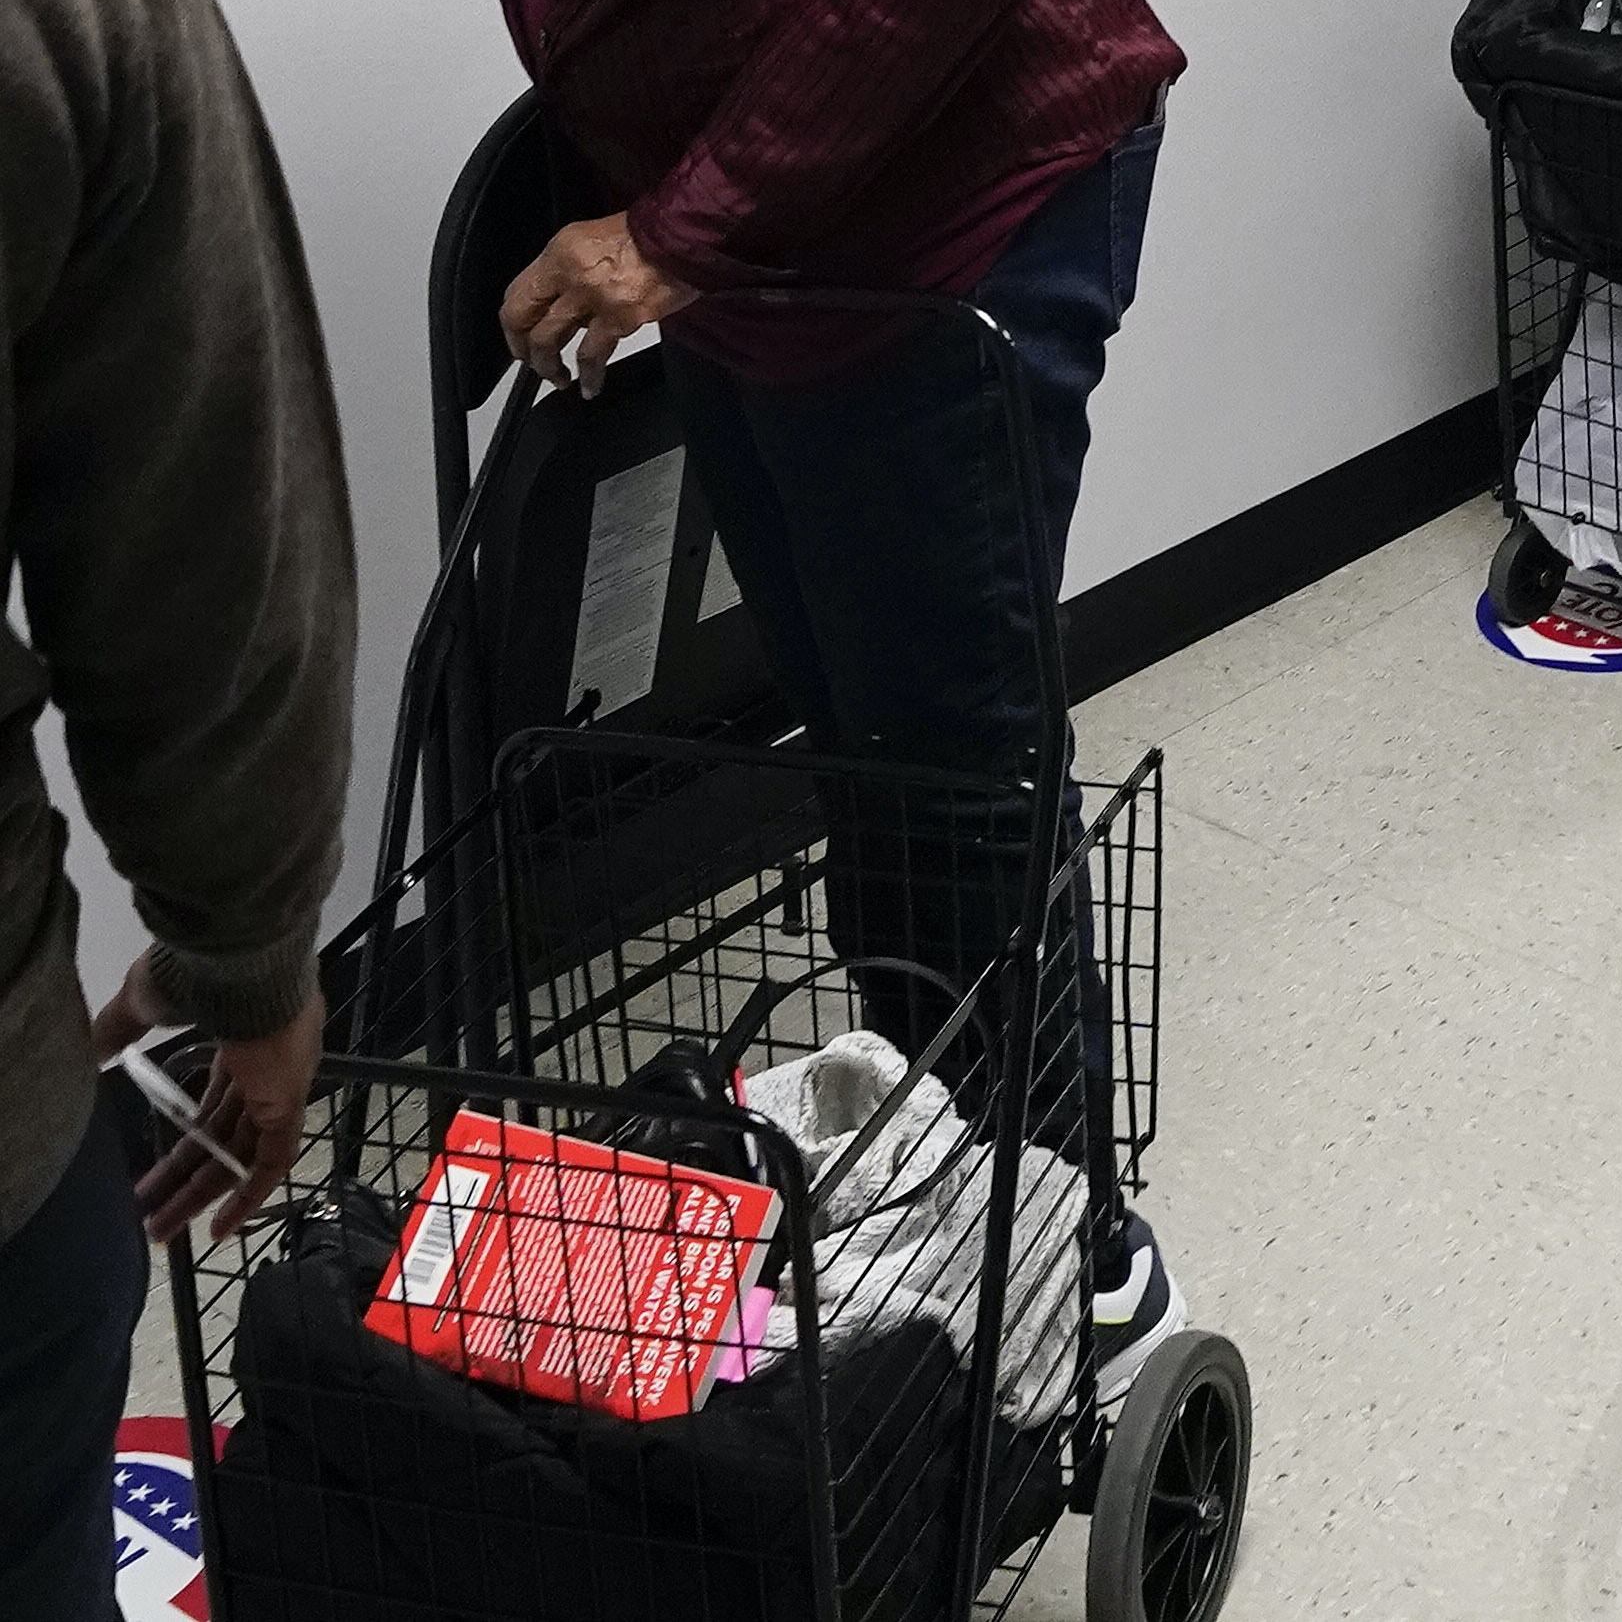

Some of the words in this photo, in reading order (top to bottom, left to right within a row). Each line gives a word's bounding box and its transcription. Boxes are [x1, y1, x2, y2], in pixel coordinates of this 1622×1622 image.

[662, 1184, 705, 1266] ALWS
[693, 1194, 721, 1236] AND
[679, 1241, 704, 1277] BIG
[683, 1292, 704, 1313] IS
[706, 1283, 726, 1304] IS
[642, 1316, 693, 1407] SLAVERY.
